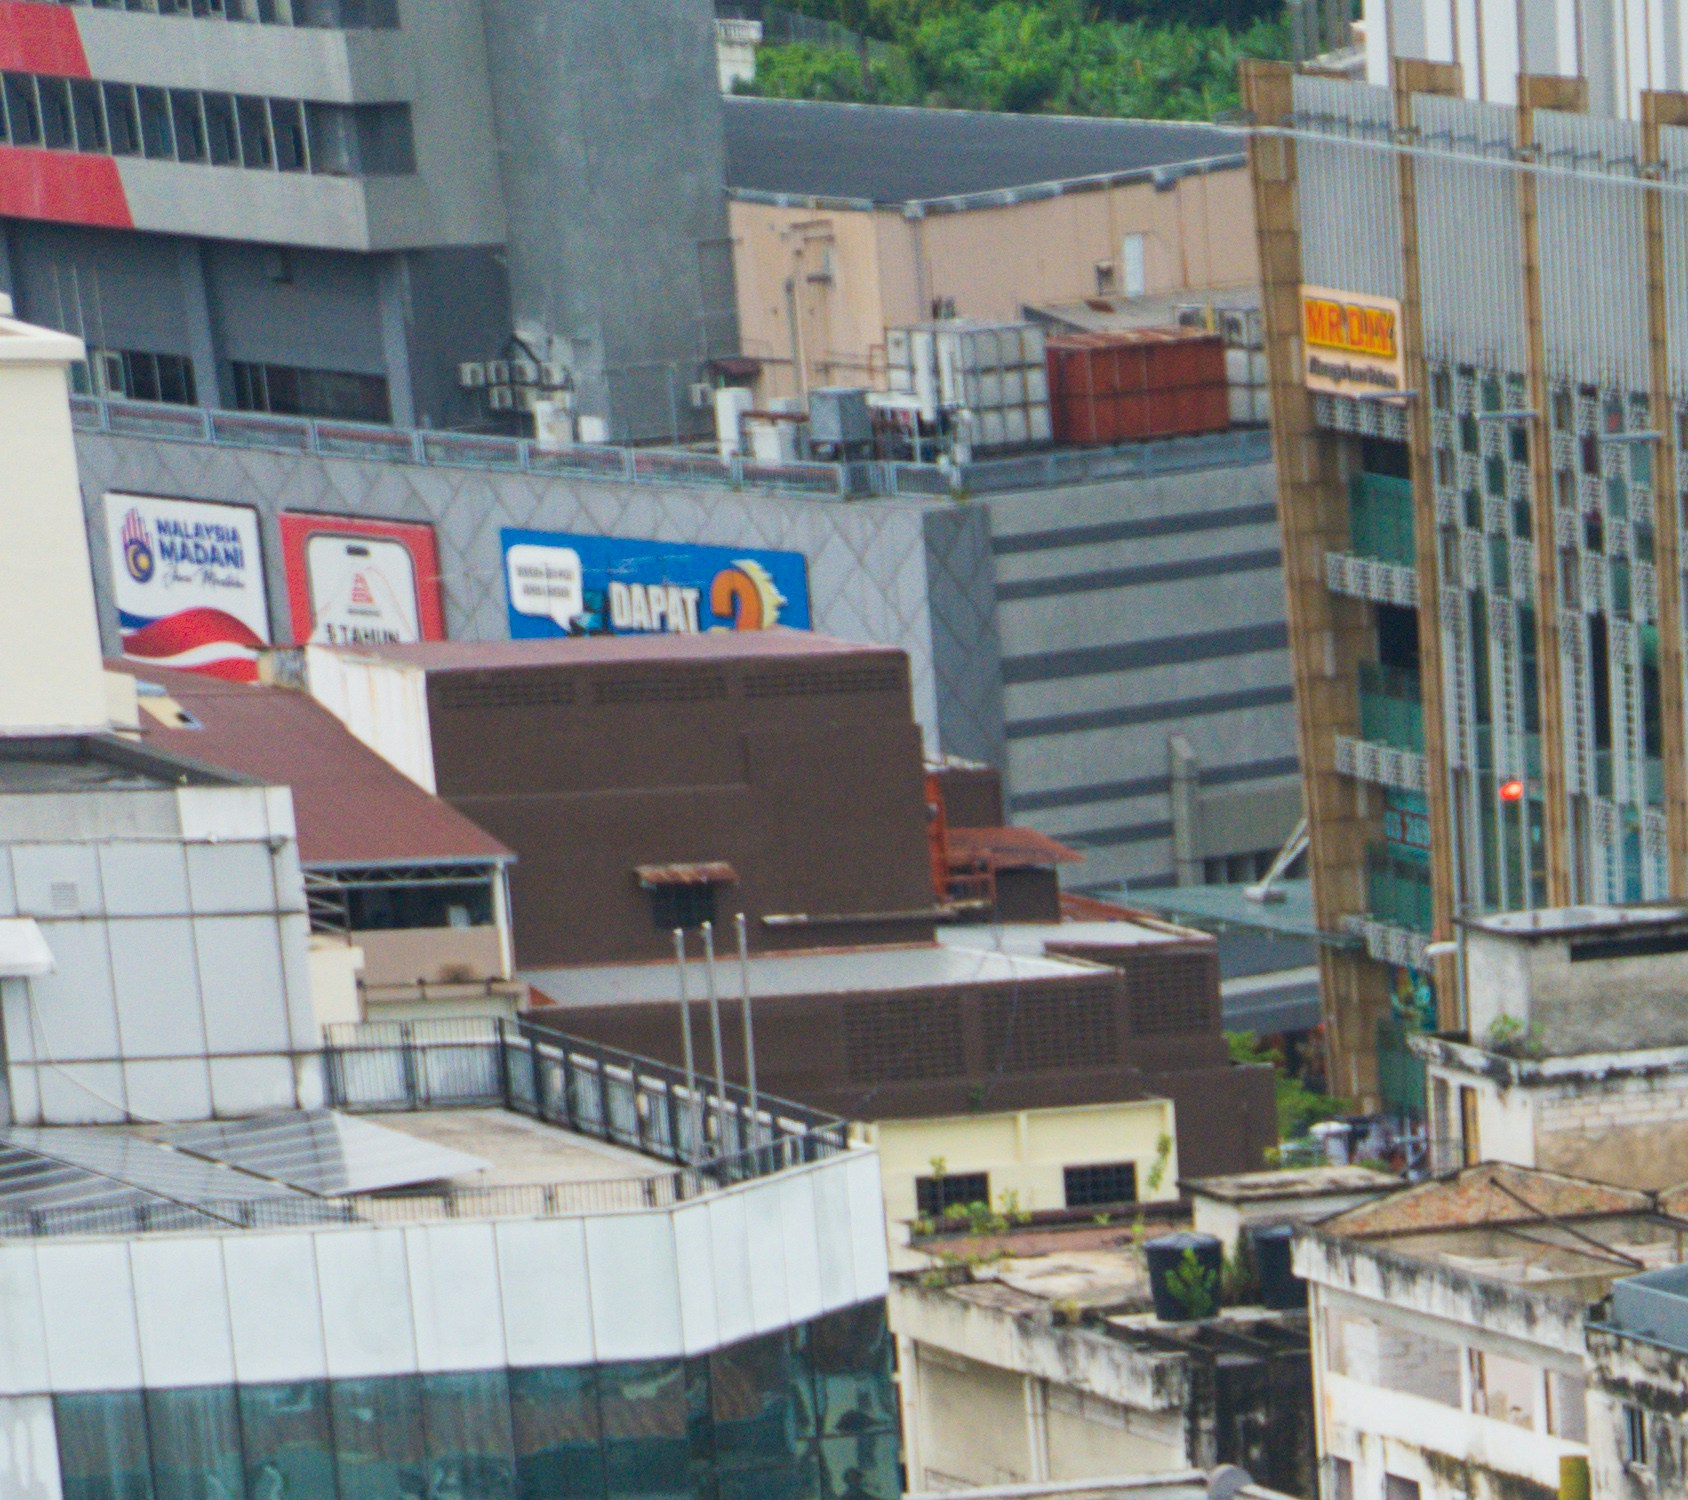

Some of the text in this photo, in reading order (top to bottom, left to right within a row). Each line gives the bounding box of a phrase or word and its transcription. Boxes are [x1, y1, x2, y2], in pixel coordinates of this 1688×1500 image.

[155, 518, 239, 542] MALAYSIA
[158, 540, 245, 569] MADANI
[608, 581, 700, 634] DAPAT
